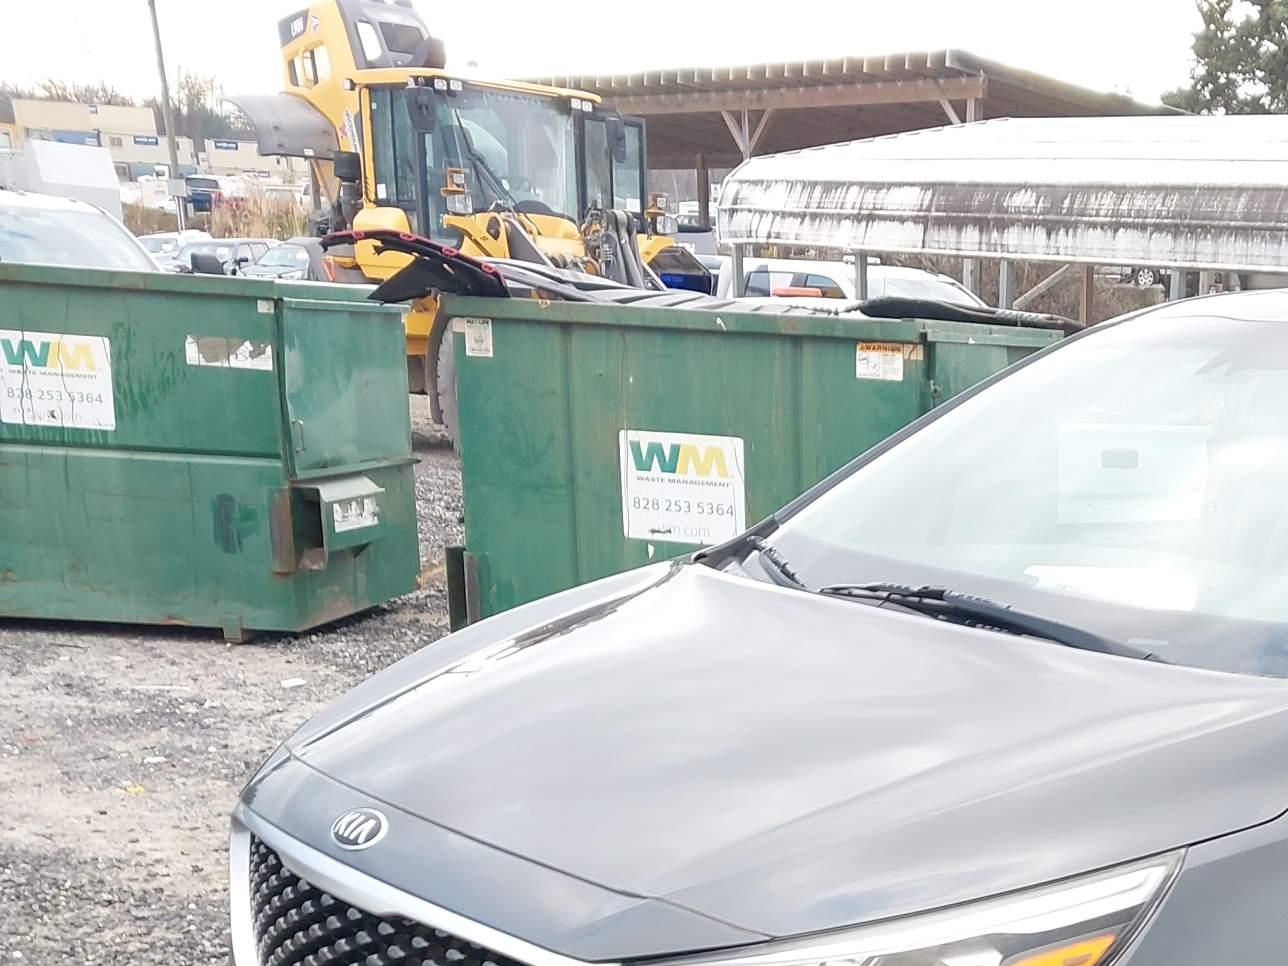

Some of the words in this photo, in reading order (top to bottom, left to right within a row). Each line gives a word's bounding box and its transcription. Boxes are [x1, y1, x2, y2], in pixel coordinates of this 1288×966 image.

[0, 338, 97, 373] WM
[39, 370, 98, 380] MANAGEMENT
[37, 388, 63, 401] 253
[68, 390, 103, 404] 5364
[629, 440, 729, 478] WM
[636, 475, 665, 483] WASTE
[667, 477, 730, 488] MANAGEMENT
[632, 495, 660, 511] 828
[664, 498, 691, 514] 253
[696, 501, 733, 517] 5364
[333, 812, 377, 844] KIA
